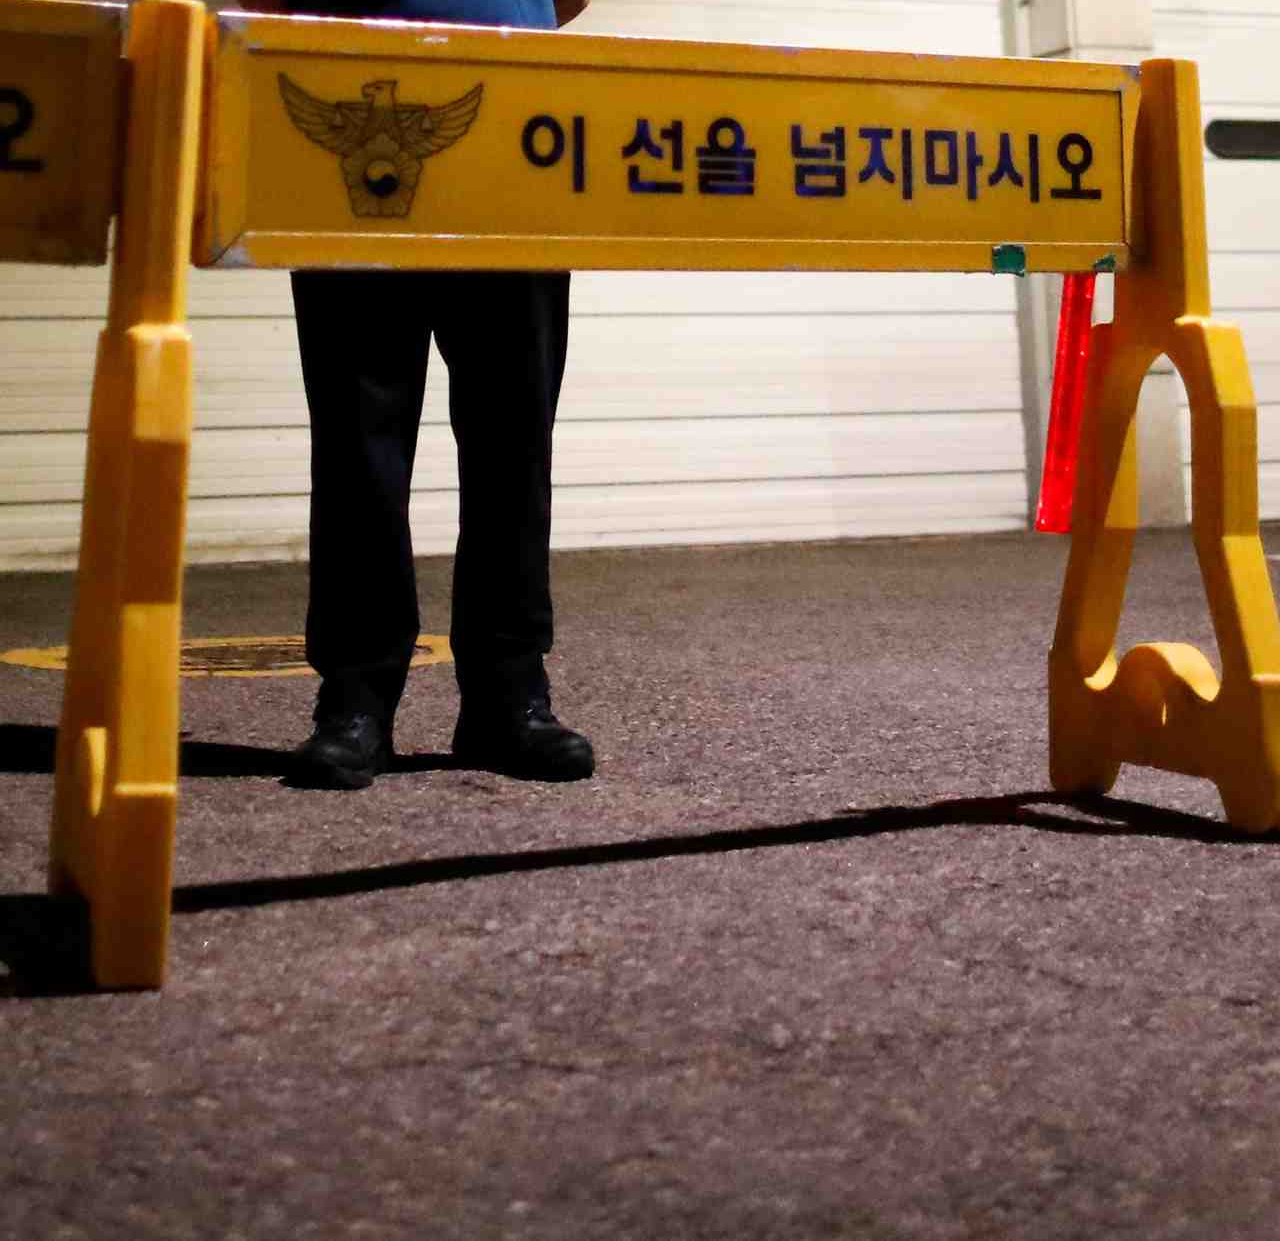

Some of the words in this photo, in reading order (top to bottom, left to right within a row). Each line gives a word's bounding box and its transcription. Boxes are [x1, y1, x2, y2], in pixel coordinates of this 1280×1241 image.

[523, 115, 585, 192] 이
[621, 117, 757, 195] 선을
[790, 124, 1102, 202] 넘지마시오
